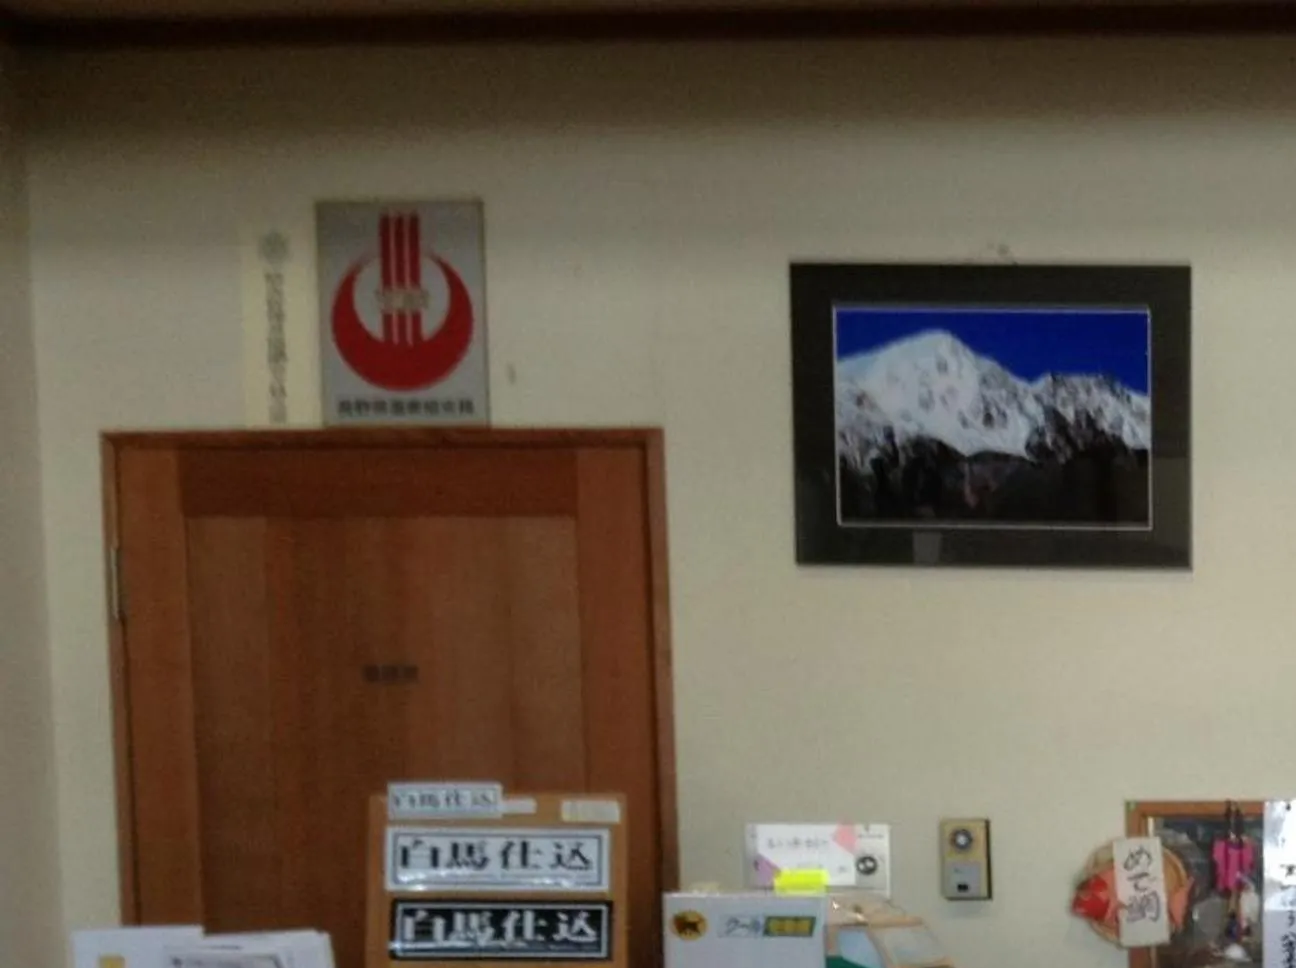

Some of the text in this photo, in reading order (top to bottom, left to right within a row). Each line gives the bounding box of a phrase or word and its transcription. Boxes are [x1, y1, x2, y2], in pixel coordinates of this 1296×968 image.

[399, 839, 594, 871] 白馬仕込
[403, 909, 598, 942] 白馬仕込
